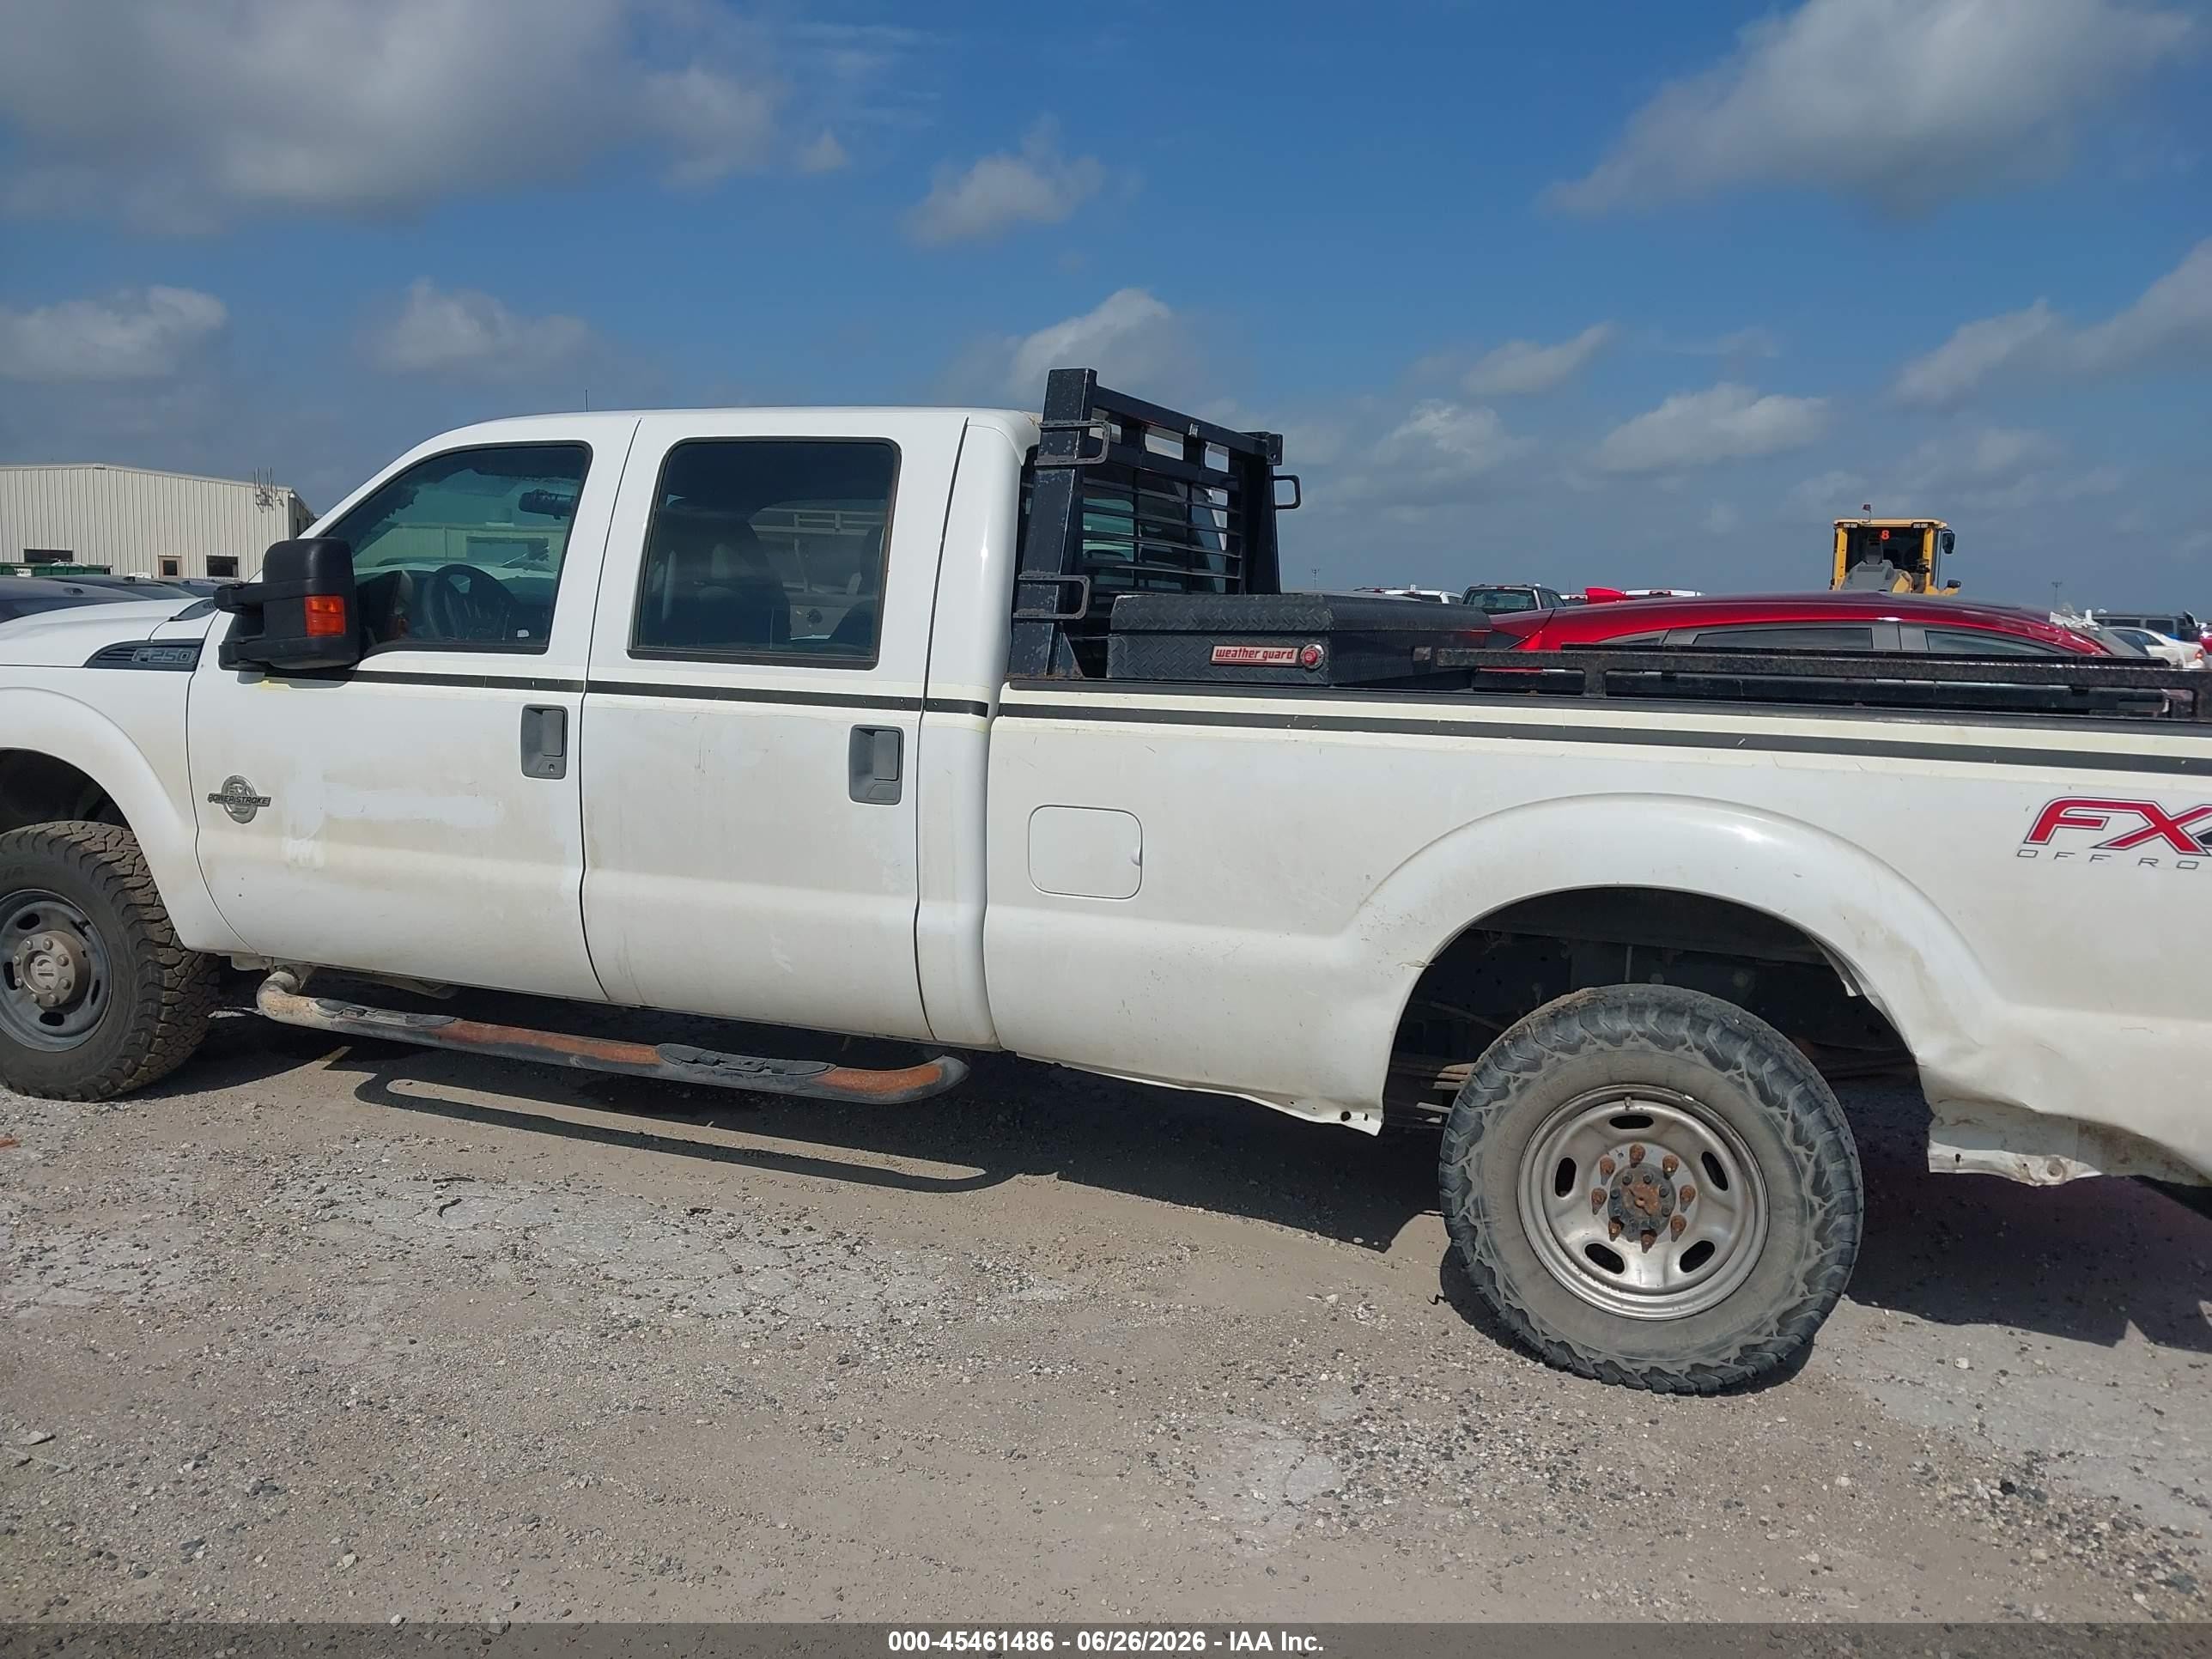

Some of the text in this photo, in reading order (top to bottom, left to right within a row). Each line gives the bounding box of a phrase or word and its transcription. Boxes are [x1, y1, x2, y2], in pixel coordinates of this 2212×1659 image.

[1881, 530, 1890, 540] 8
[131, 648, 194, 664] F-250
[1215, 647, 1294, 661] weather guard
[2023, 796, 2212, 856] FX
